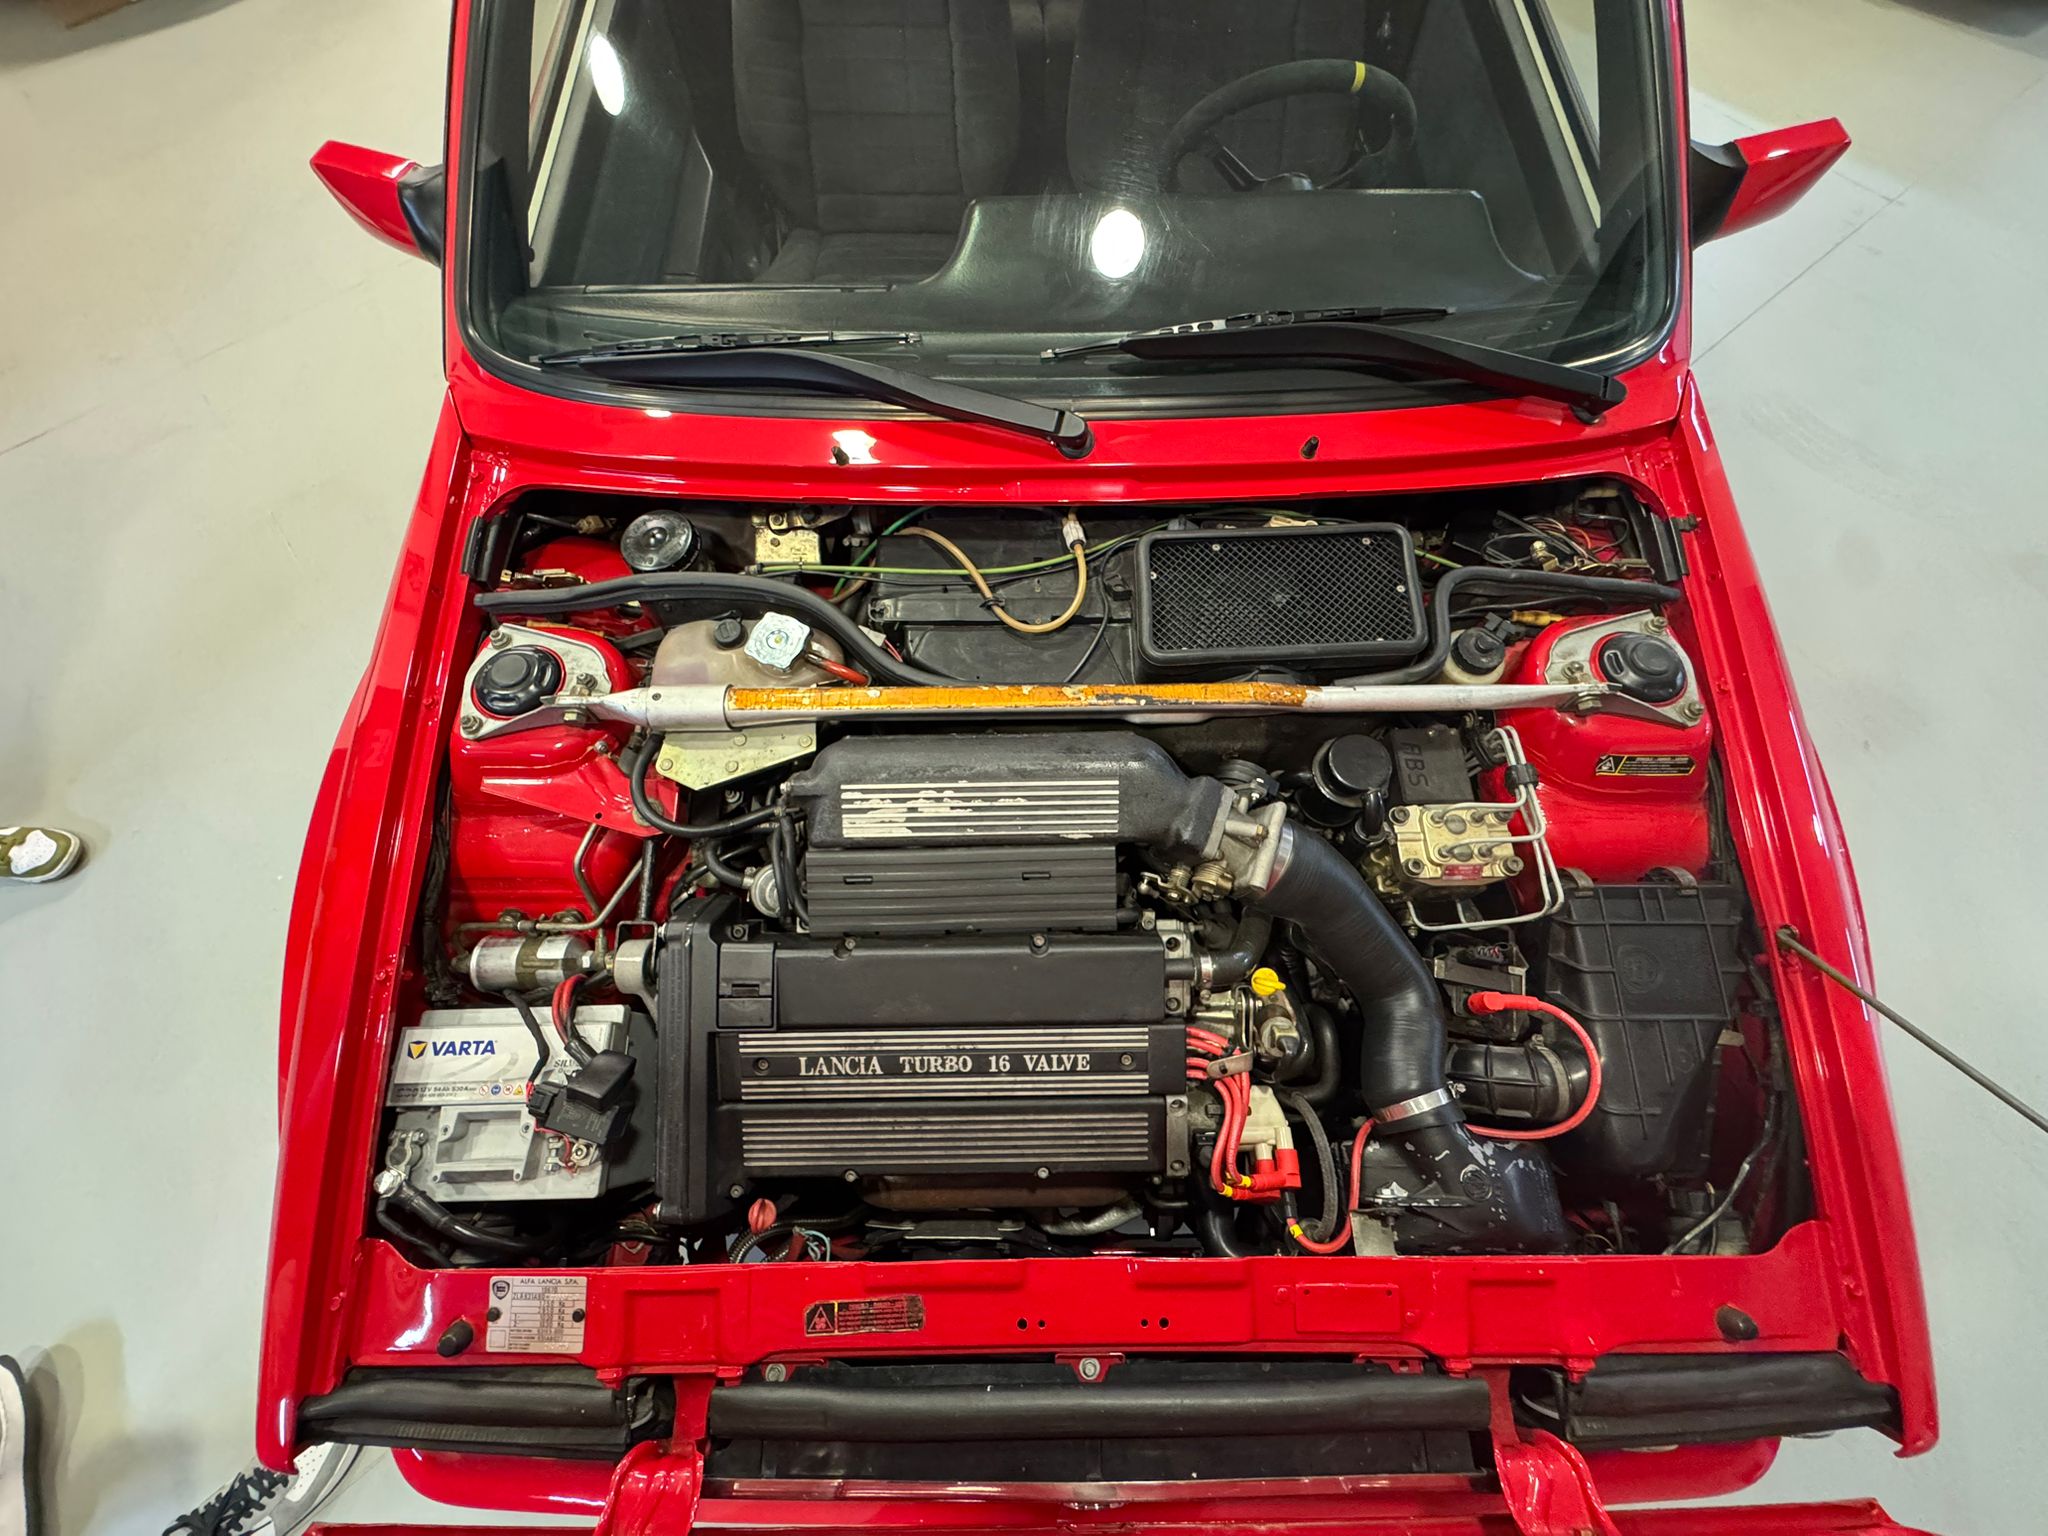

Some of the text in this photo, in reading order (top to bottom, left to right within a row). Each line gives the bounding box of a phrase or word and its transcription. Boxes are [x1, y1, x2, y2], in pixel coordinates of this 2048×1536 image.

[1401, 742, 1430, 789] ABS
[432, 1040, 496, 1056] VARTA
[798, 1053, 1091, 1076] LANCIA TURBO 16 VALVE
